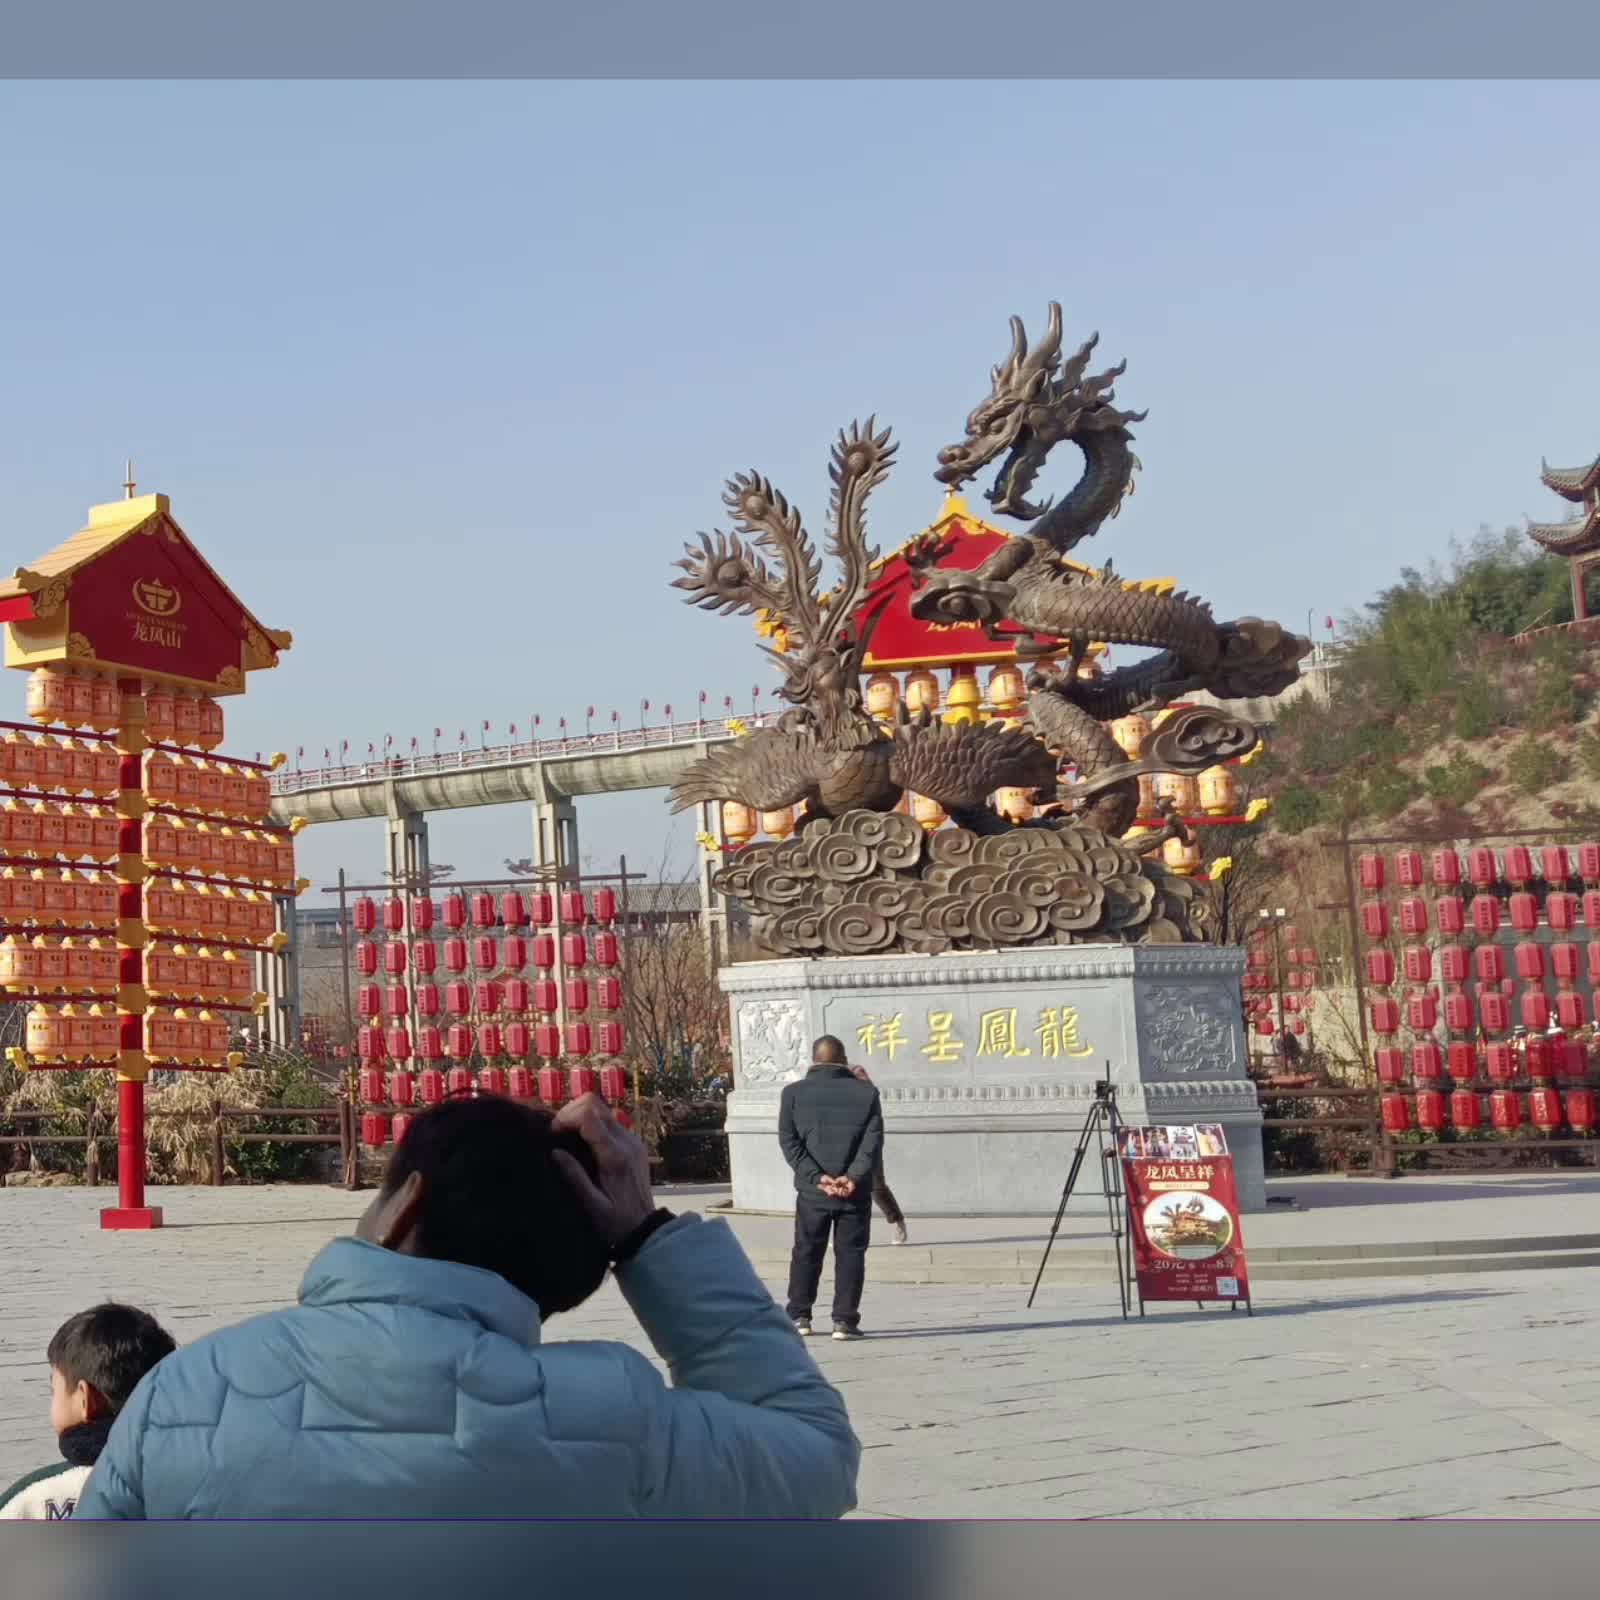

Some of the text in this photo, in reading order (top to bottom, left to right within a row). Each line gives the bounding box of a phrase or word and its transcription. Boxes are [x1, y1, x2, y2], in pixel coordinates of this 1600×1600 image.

[132, 620, 182, 649] 龙凤山
[1143, 1164, 1216, 1180] 龙凤呈祥
